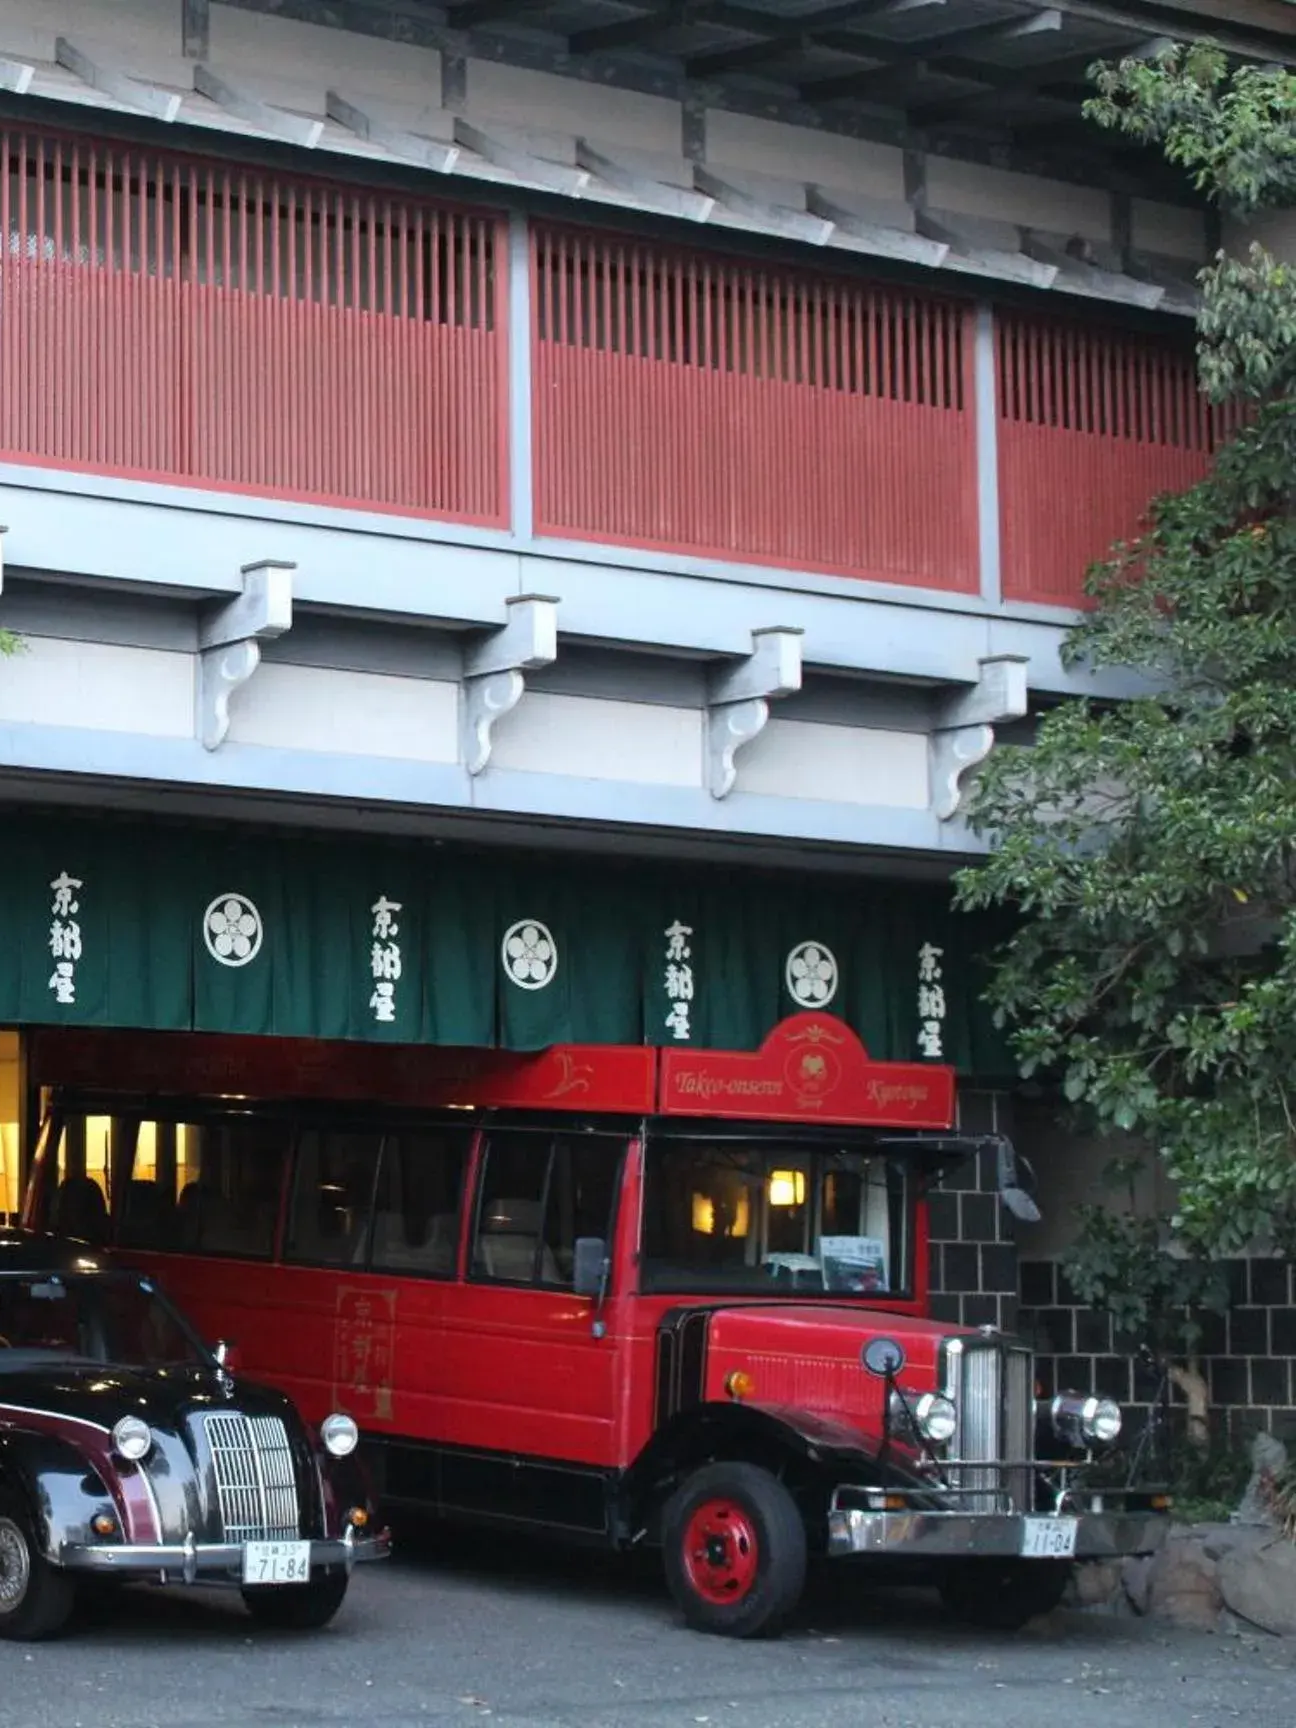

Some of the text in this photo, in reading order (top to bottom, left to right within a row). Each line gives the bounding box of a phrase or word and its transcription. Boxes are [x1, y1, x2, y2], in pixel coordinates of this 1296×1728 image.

[47, 871, 84, 1004] 京都屋
[369, 895, 402, 1022] 京都屋
[663, 920, 694, 1040] 京都屋
[917, 943, 946, 1057] 京都屋
